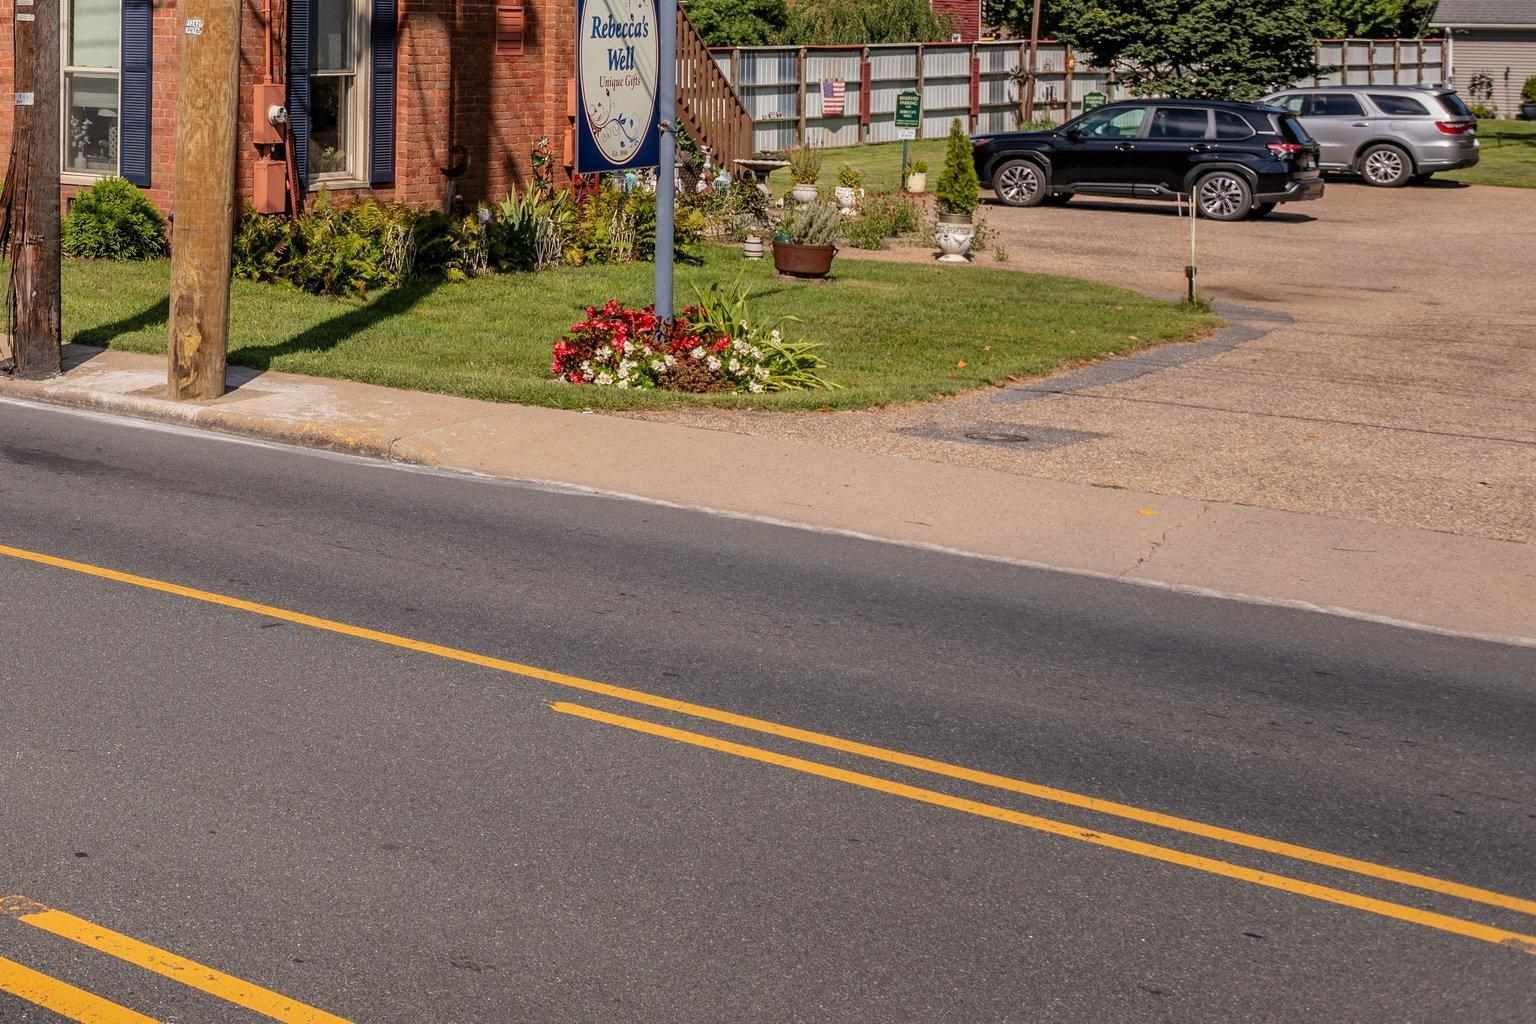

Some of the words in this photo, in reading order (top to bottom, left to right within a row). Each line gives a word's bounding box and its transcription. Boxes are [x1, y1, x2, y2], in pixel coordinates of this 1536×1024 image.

[590, 14, 649, 39] Rebecca's
[607, 46, 635, 71] Well
[599, 75, 623, 92] Unique
[625, 74, 641, 90] Gifts
